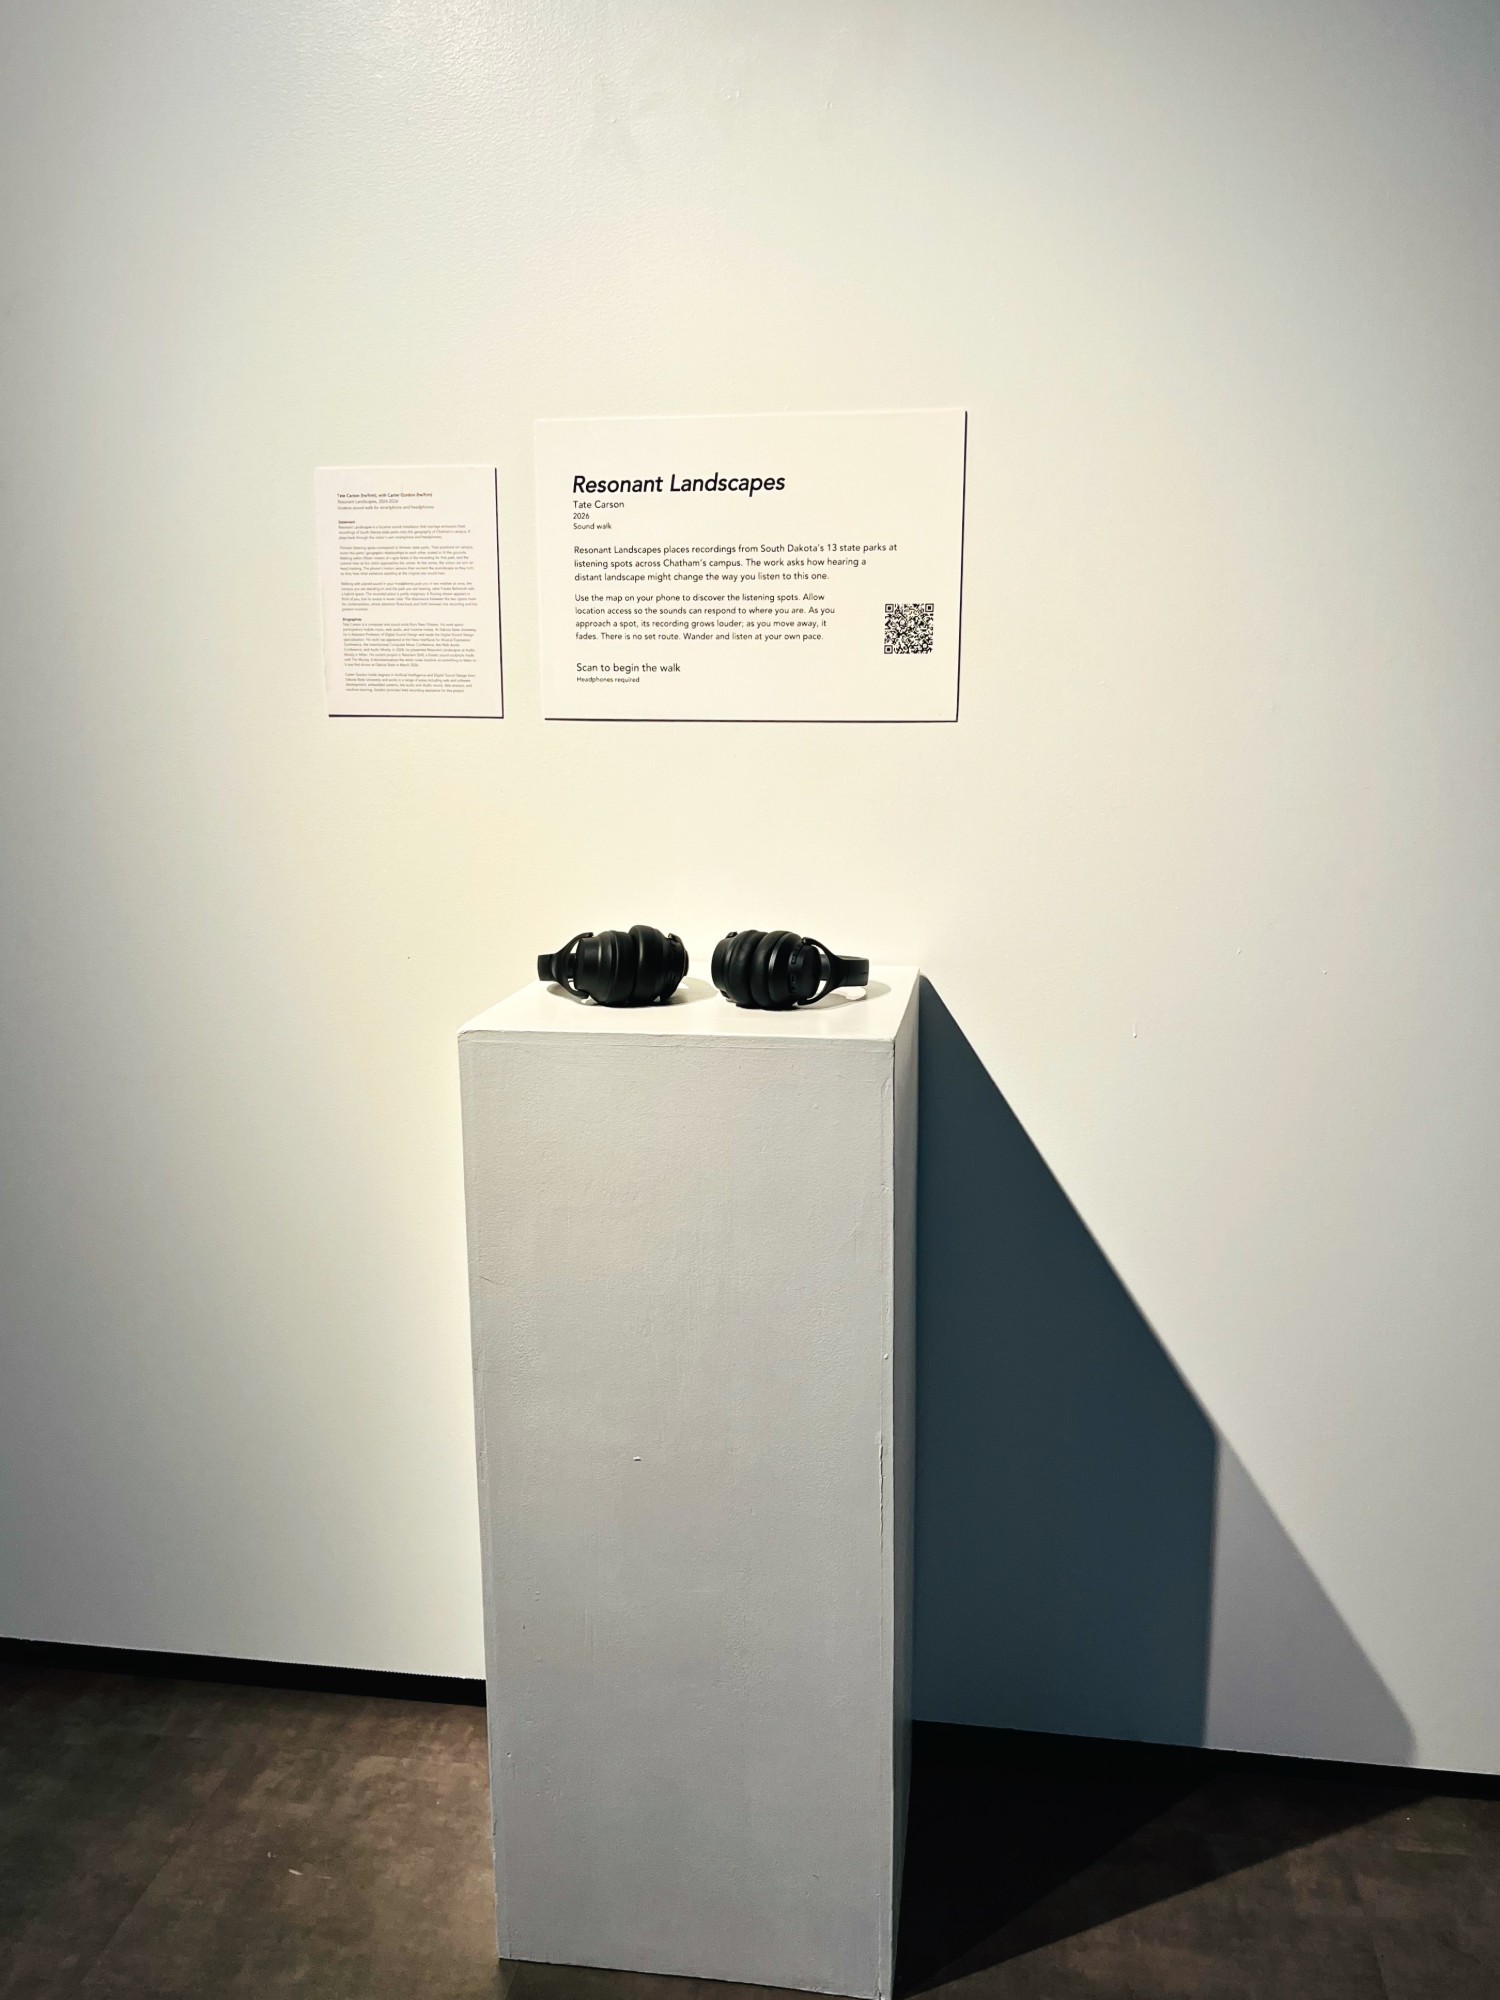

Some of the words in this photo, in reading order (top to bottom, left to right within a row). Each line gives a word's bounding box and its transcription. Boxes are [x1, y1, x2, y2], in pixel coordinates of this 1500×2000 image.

[572, 475, 663, 493] Resonant
[670, 471, 785, 498] Landscapes
[572, 500, 592, 509] Tate
[594, 500, 625, 509] Carson
[573, 522, 595, 530] Sound
[596, 522, 612, 530] walk
[574, 545, 611, 554] Resonant
[614, 545, 661, 556] Landscapes
[663, 545, 690, 556] places
[691, 545, 737, 556] recordings
[738, 543, 759, 552] from
[760, 544, 785, 553] South
[827, 543, 837, 551] 13
[839, 544, 861, 552] state
[863, 542, 887, 554] parks
[574, 559, 609, 570] listening
[610, 560, 633, 570] spots
[708, 560, 743, 569] campus.
[745, 558, 761, 567] The
[763, 558, 784, 567] work
[786, 557, 805, 566] asks
[806, 557, 825, 566] how
[827, 557, 859, 568] hearing
[574, 572, 602, 581] distant
[604, 572, 645, 584] landscape
[647, 572, 671, 583] might
[673, 572, 704, 583] change
[705, 572, 720, 581] the
[721, 574, 738, 583] way
[740, 574, 756, 582] you
[758, 572, 780, 580] listen
[793, 571, 809, 580] this
[606, 595, 623, 604] map
[636, 595, 654, 603] your
[656, 593, 681, 603] phone
[727, 593, 741, 601] the
[742, 593, 775, 603] listening
[776, 594, 800, 603] spots.
[802, 593, 825, 601] Allow
[575, 607, 605, 615] location
[644, 606, 658, 615] the
[659, 606, 687, 615] sounds
[704, 606, 737, 617] respond
[748, 606, 773, 615] where
[774, 608, 789, 616] you
[820, 608, 835, 616] you
[575, 620, 611, 629] approach
[619, 620, 639, 629] spot,
[652, 620, 689, 629] recording
[796, 621, 819, 629] away,
[821, 619, 827, 627] it
[575, 632, 598, 640] fades.
[600, 632, 623, 640] There
[682, 632, 713, 640] Wander
[715, 632, 730, 640] and
[732, 632, 753, 640] listen
[764, 634, 782, 642] your
[802, 634, 823, 642] pace.
[576, 662, 598, 672] Scan
[600, 664, 611, 672] to
[613, 662, 640, 675] begin
[641, 662, 657, 673] the
[659, 662, 681, 673] walk
[576, 676, 613, 684] Headphones
